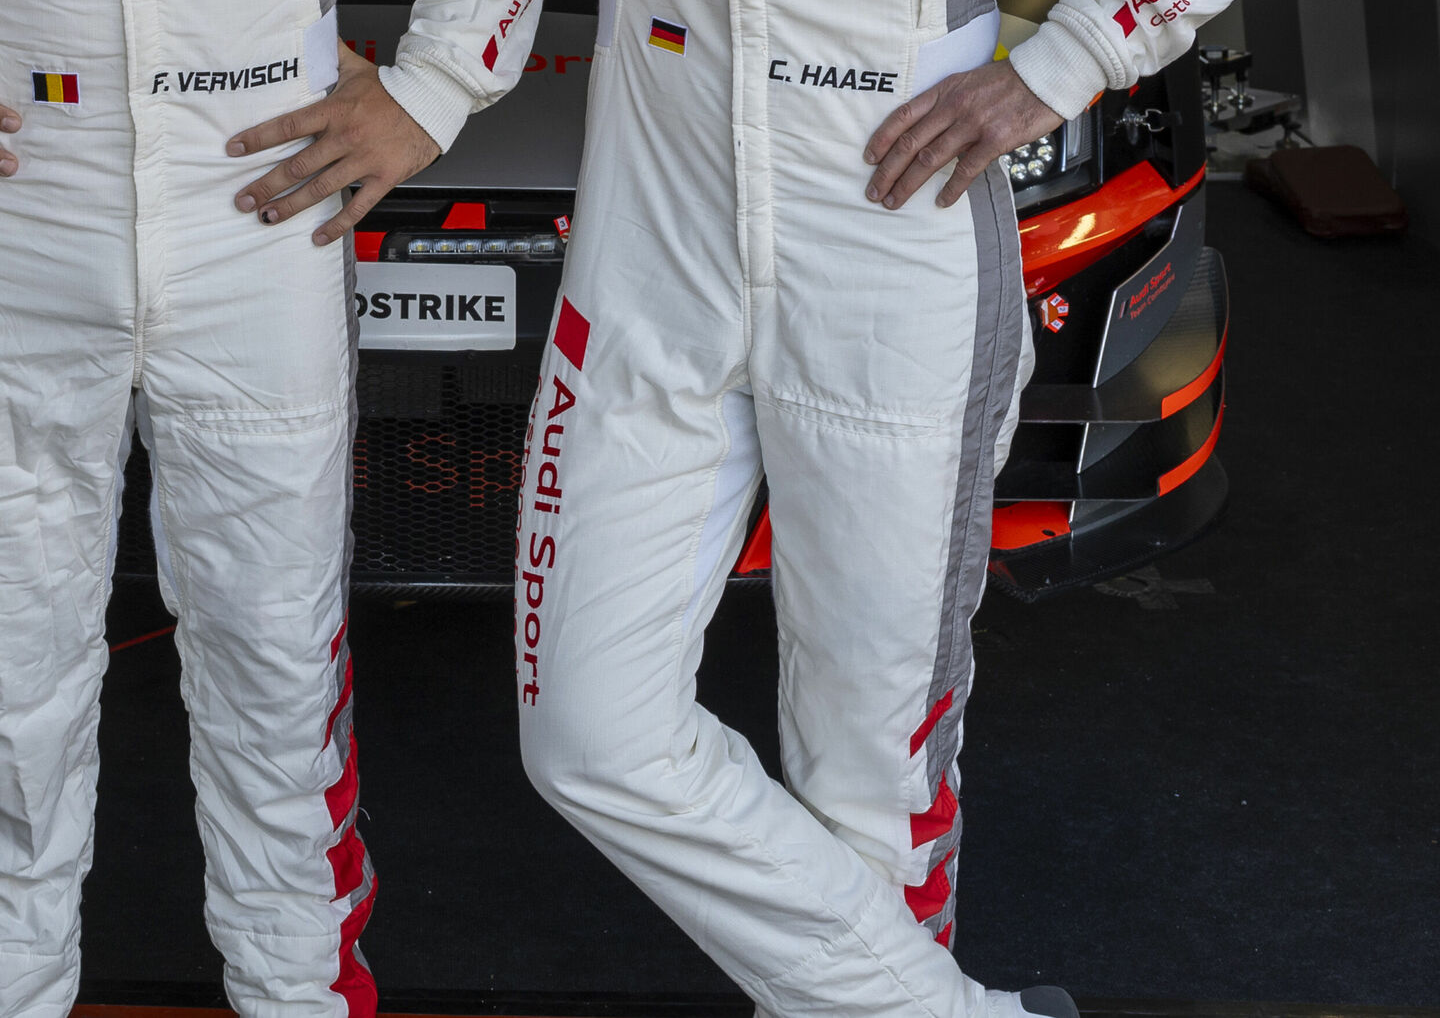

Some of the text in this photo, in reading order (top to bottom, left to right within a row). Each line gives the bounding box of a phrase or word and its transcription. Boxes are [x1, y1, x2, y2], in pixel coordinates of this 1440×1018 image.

[152, 57, 299, 94] F. VERVISCH
[768, 59, 899, 93] C. HAASE
[522, 374, 576, 707] Audi Sport
